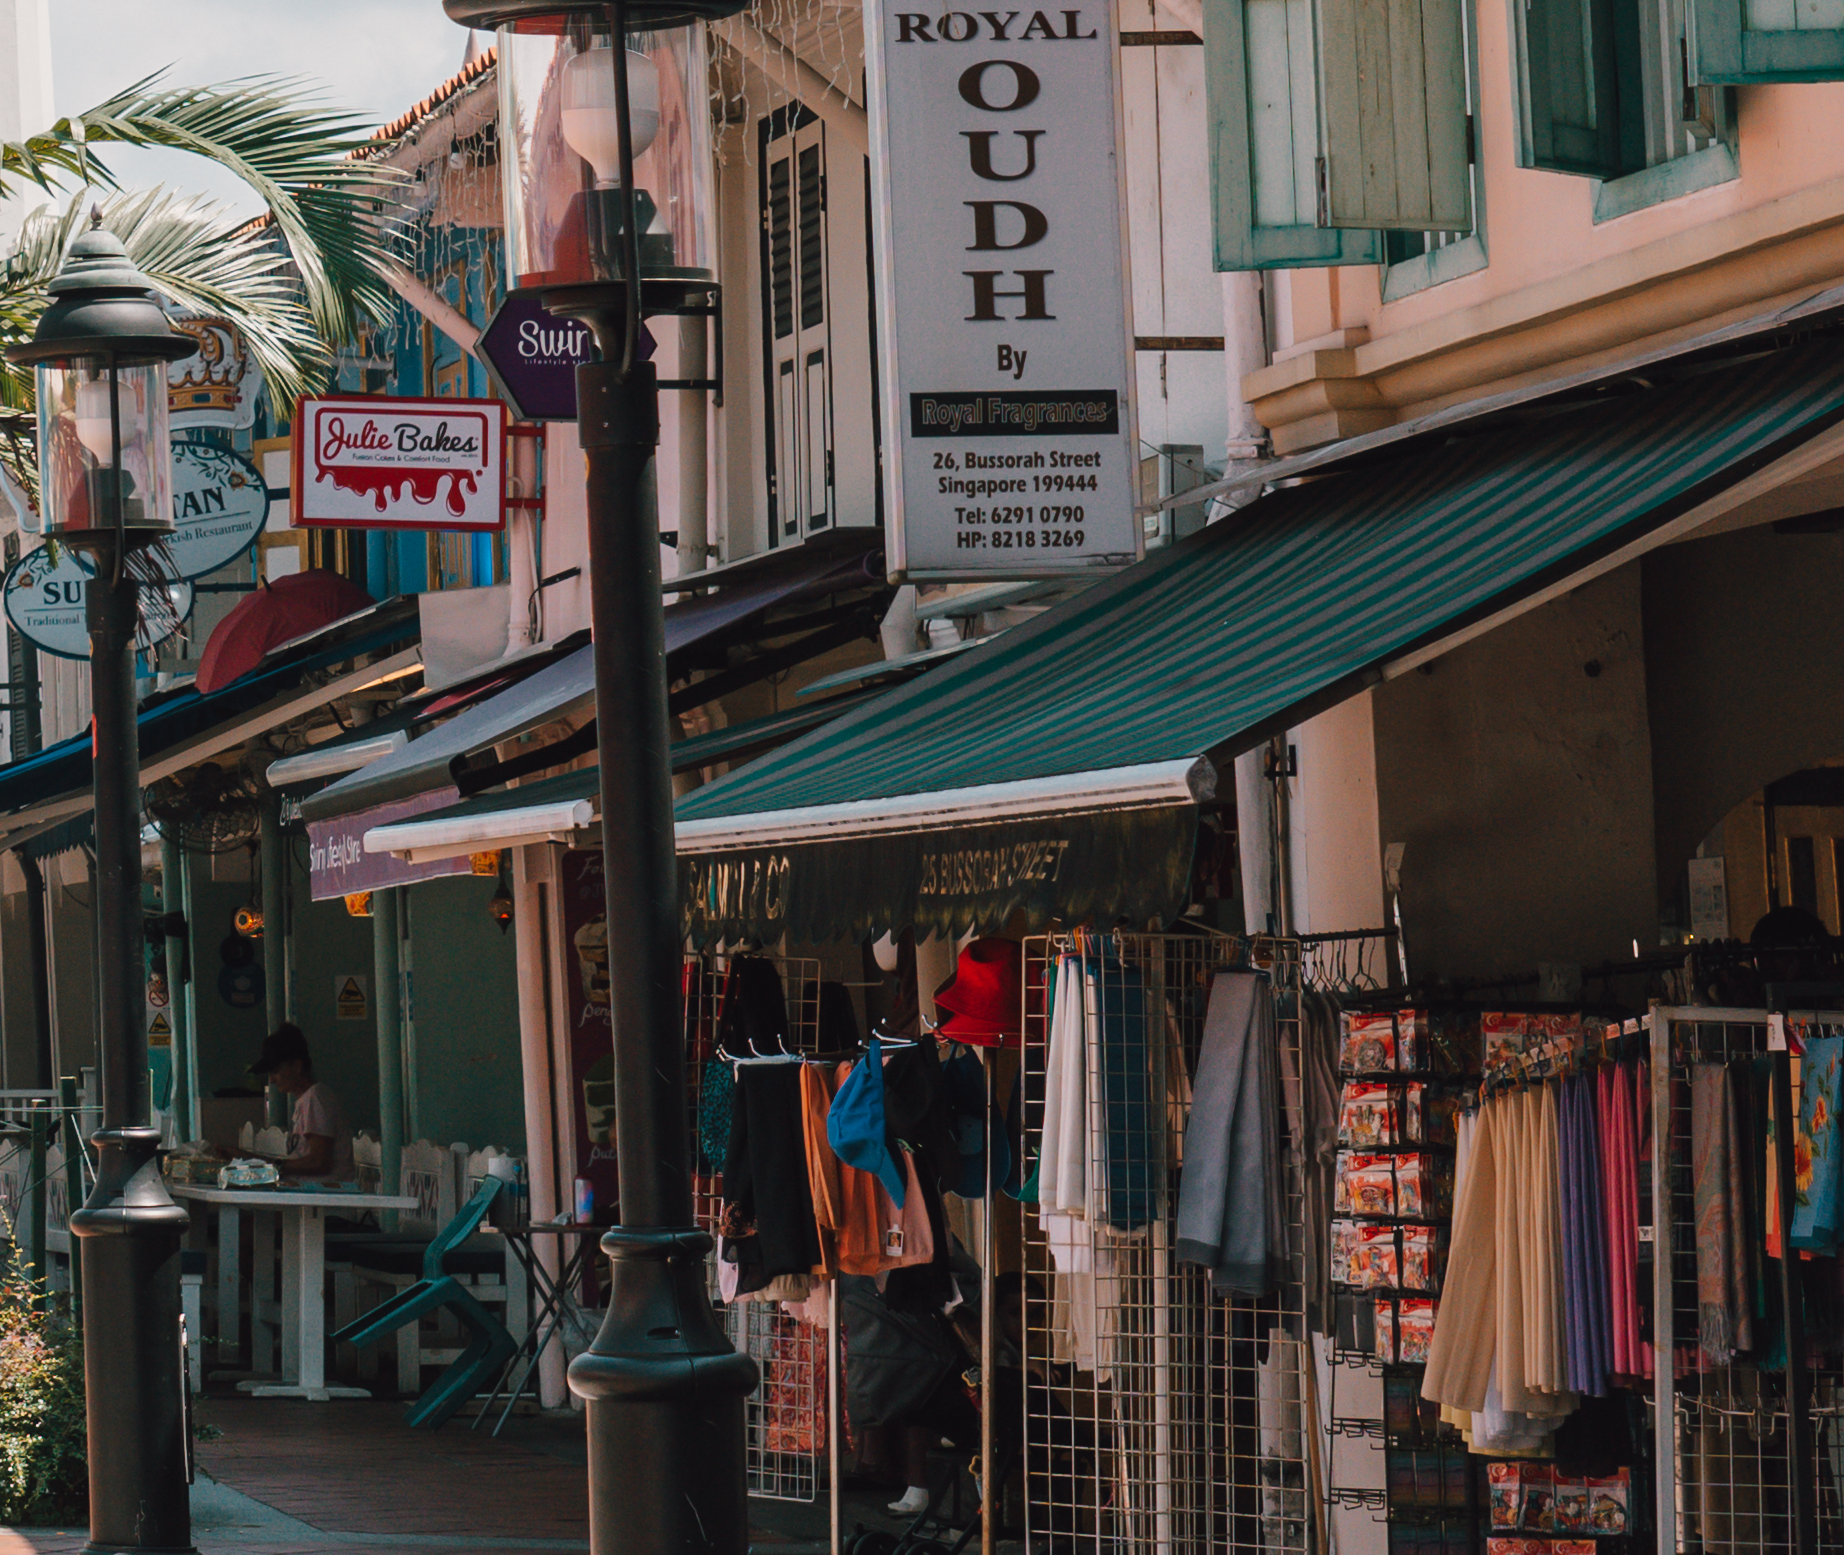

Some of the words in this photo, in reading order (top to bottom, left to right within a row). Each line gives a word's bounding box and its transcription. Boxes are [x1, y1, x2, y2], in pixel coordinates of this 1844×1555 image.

[894, 9, 1099, 44] ROYAL
[956, 58, 1057, 323] OUDH
[997, 344, 1027, 380] By
[921, 398, 983, 433] Royal
[988, 397, 1108, 432] Fragrances
[323, 417, 393, 461] Julie
[394, 421, 479, 452] Bakes
[933, 452, 960, 472] 26,
[965, 451, 1045, 469] Bussorah
[1049, 450, 1101, 468] Street
[938, 476, 1027, 498] Singapore
[1033, 474, 1098, 492] 199444
[955, 507, 986, 524] Tel:
[991, 506, 1034, 524] 6291
[1039, 505, 1085, 523] 0790
[195, 520, 254, 539] Restaurant
[957, 531, 987, 548] HP:
[991, 531, 1036, 548] 8218
[1040, 529, 1085, 547] 3269
[24, 614, 80, 627] Traditional
[920, 854, 937, 894] 25
[941, 846, 1011, 895] BUSSORAH
[1008, 840, 1069, 886] STREET
